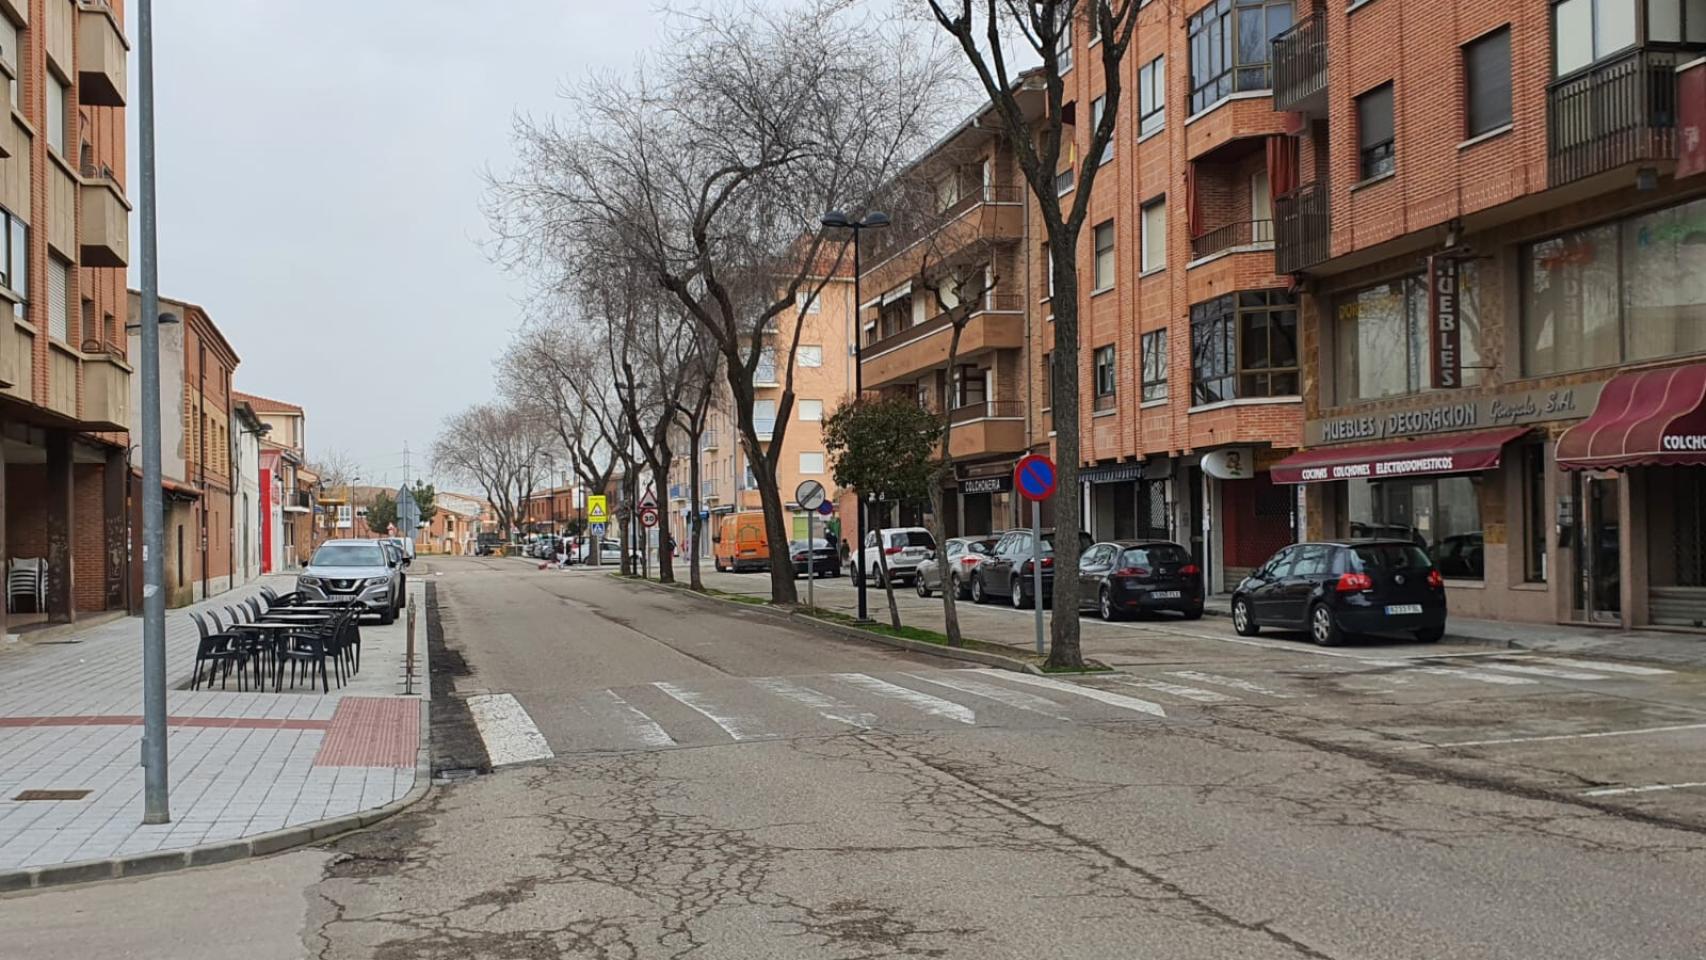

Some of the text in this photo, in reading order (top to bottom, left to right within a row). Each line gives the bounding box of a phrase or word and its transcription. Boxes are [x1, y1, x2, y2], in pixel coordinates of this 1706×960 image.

[1322, 416, 1376, 441] MUEBLES
[1389, 404, 1477, 433] DECORACION
[1545, 390, 1576, 413] S.A.
[1302, 457, 1453, 480] COCINAS COLCHONES ELECTRODOMESTICOS
[965, 479, 1000, 492] COLCHONERIA
